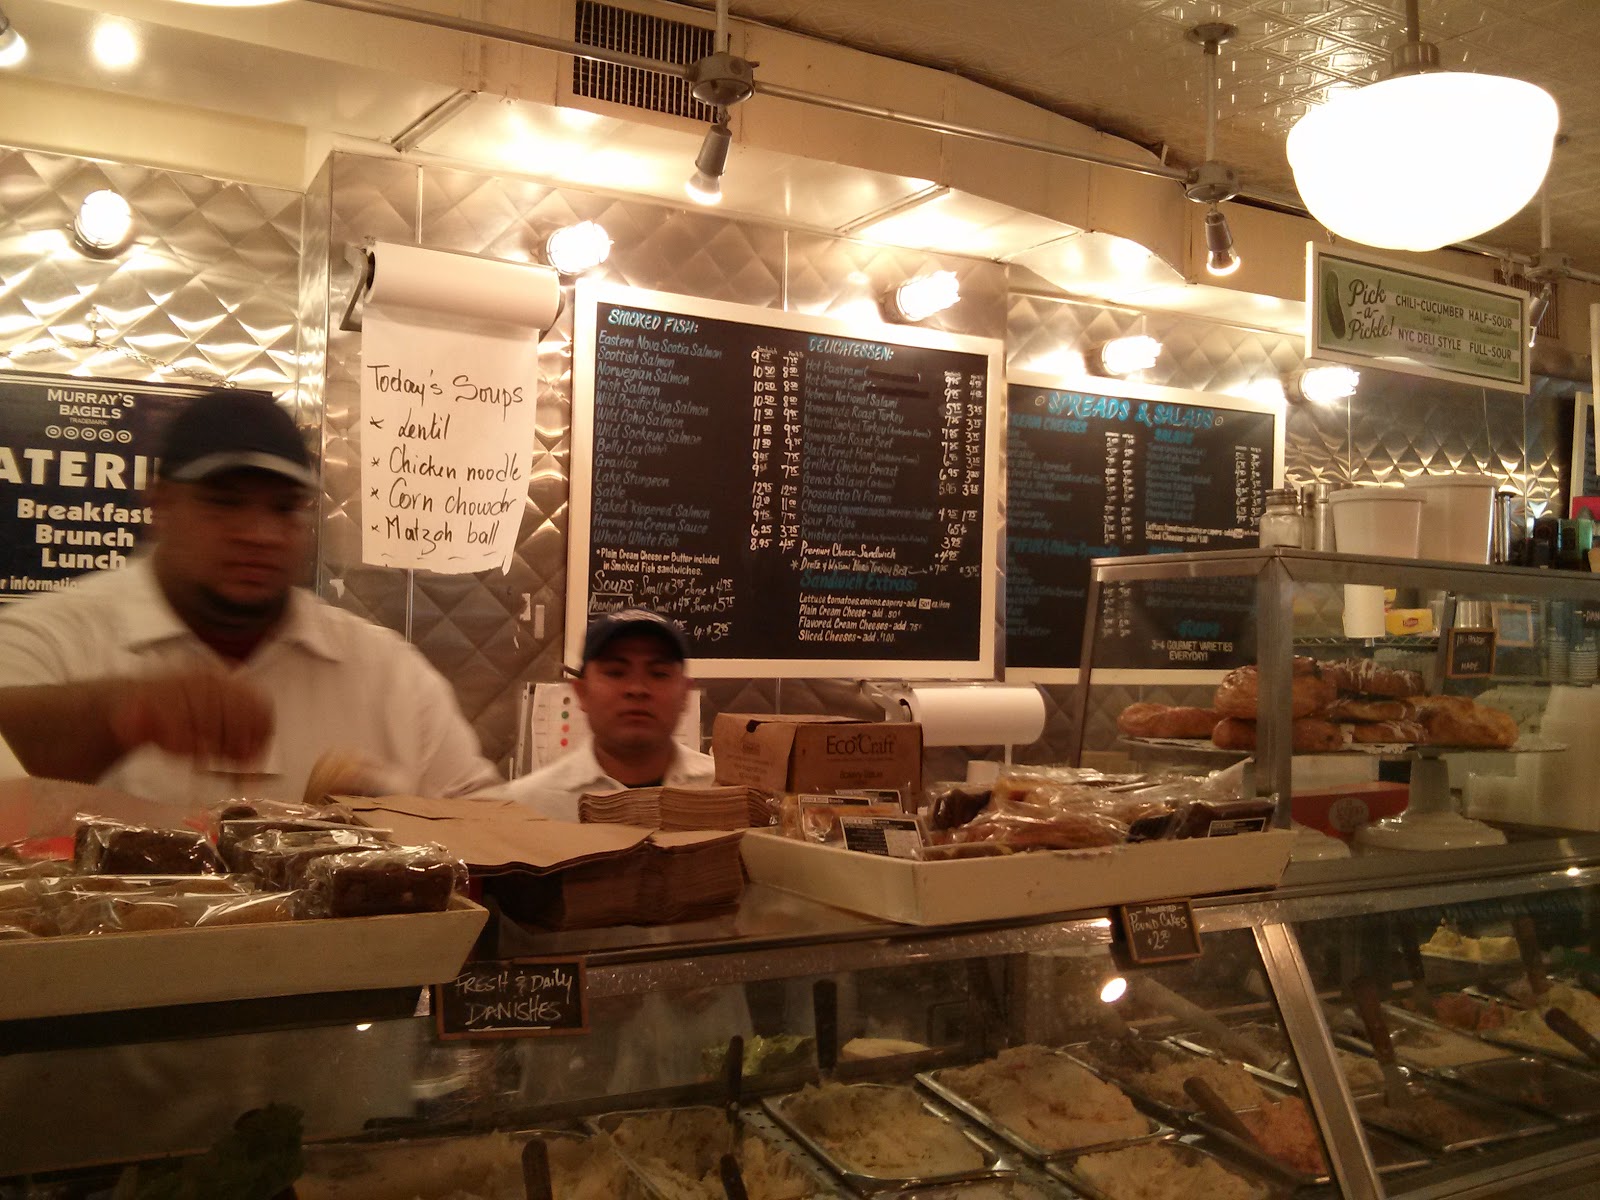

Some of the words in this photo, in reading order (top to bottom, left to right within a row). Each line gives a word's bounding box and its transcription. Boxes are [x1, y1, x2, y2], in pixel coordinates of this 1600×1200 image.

[1348, 278, 1387, 307] Pick
[608, 308, 662, 331] SMOKED
[1395, 294, 1464, 320] CHILI-CUCUMBER
[1468, 309, 1513, 329] HALF-SOUR
[1348, 316, 1395, 341] Pickle!
[598, 330, 634, 347] Eastern
[637, 335, 660, 351] Nova
[660, 339, 690, 354] Scotia
[690, 343, 723, 359] Salmon
[1398, 328, 1415, 343] NYC
[1417, 331, 1435, 347] DELI
[1437, 335, 1462, 352] STYLE
[1469, 342, 1512, 361] FULL-SOUR
[598, 346, 639, 364] Scottish
[640, 352, 675, 367] Salmon
[597, 361, 652, 382] Norwegian
[654, 368, 690, 385] Salmon
[367, 364, 443, 407] Today's
[452, 374, 524, 422] Soups
[597, 376, 620, 392] Irish
[622, 379, 660, 396] Salmon
[47, 388, 136, 408] MURRAY'S
[673, 400, 709, 416] Salmon
[59, 404, 122, 420] BAGELS
[597, 407, 620, 422] Wild
[621, 409, 645, 424] Coho
[646, 411, 684, 428] Salmon
[852, 405, 877, 420] Roast
[878, 408, 904, 425] Turkey
[1047, 392, 1130, 421] SPREADS
[1134, 402, 1152, 428] &
[1153, 405, 1214, 429] SALADS
[69, 417, 108, 426] TRADEMARK
[596, 422, 620, 438] Wild
[622, 425, 664, 442] Sockeye
[666, 429, 702, 445] Salmon
[848, 432, 874, 446] Roast
[596, 437, 624, 456] Belly
[389, 443, 457, 480] Chicken
[466, 452, 522, 483] noodle
[595, 468, 622, 483] Lake
[623, 471, 671, 488] Sturgeon
[389, 477, 433, 513] Corn
[595, 482, 626, 498] Sable
[17, 498, 153, 525] Breakfast
[594, 498, 628, 513] Baked
[676, 504, 710, 519] Salmon
[593, 513, 634, 530] Herring
[644, 517, 676, 531] Cream
[678, 519, 709, 535] Sauce
[801, 513, 822, 526] Sour
[825, 515, 856, 528] Pickles
[35, 523, 135, 548] Brunch
[385, 514, 453, 556] Matzoh
[467, 520, 500, 545] ball
[593, 529, 627, 544] Whole
[658, 532, 679, 547] Fish
[41, 548, 127, 570] Lunch
[601, 547, 618, 558] Plain
[619, 549, 640, 560] Cream
[640, 550, 662, 561] Cheese
[670, 551, 693, 563] Butter
[693, 554, 720, 565] included
[610, 559, 639, 572] Smoked
[641, 561, 656, 573] Fish
[656, 563, 703, 576] sandwiches.
[800, 570, 863, 589] Sandwich
[798, 604, 817, 616] Plain
[818, 605, 841, 617] Cream
[798, 616, 832, 629] Flavored
[833, 618, 857, 630] Cream
[798, 629, 823, 641] Sliced
[455, 971, 509, 994] FRESH
[464, 994, 563, 1026] DANISHES
